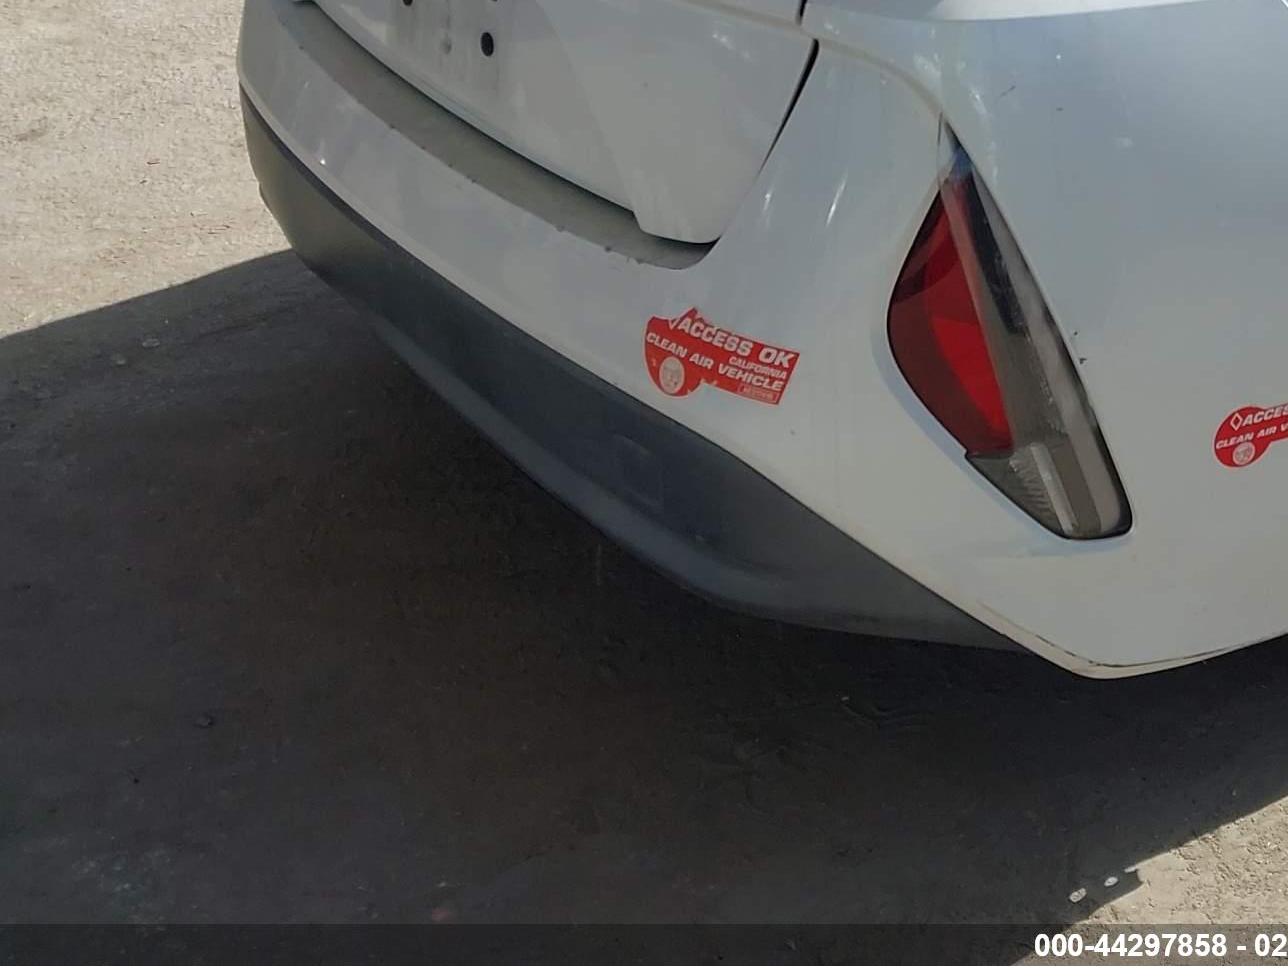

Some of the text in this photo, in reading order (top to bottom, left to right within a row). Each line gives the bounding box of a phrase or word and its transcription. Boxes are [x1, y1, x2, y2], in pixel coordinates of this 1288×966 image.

[646, 332, 785, 391] CLEAN AIR VEHICLE
[677, 317, 796, 369] ACCESS OK
[728, 356, 788, 380] CALIFORNIA
[1215, 432, 1254, 450] CLEAN
[1256, 425, 1278, 439] AIR
